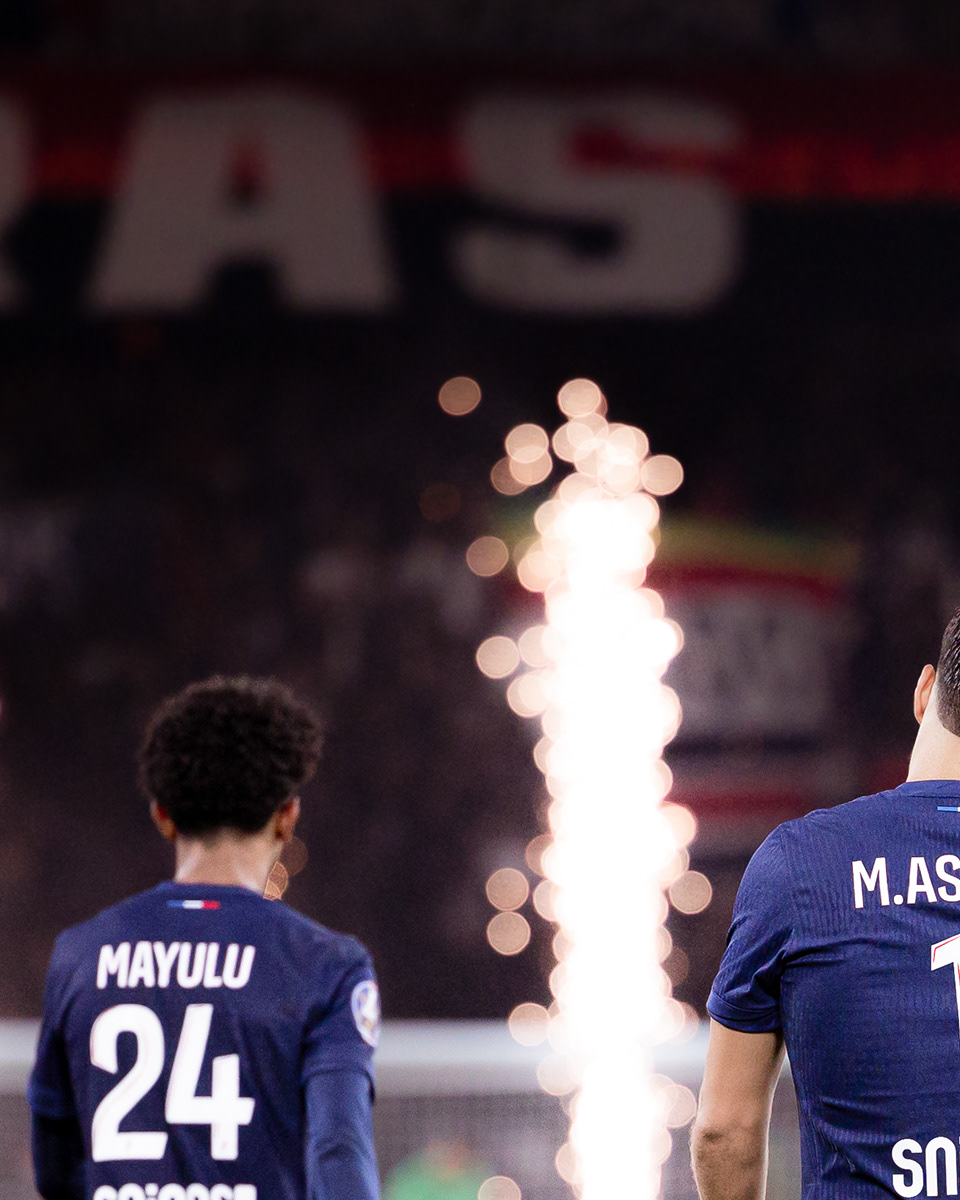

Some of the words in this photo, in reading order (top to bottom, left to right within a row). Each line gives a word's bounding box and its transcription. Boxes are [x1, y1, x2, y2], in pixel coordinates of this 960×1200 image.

[0, 88, 742, 312] AS
[96, 941, 255, 989] MAYULU
[90, 1003, 255, 1162] 24
